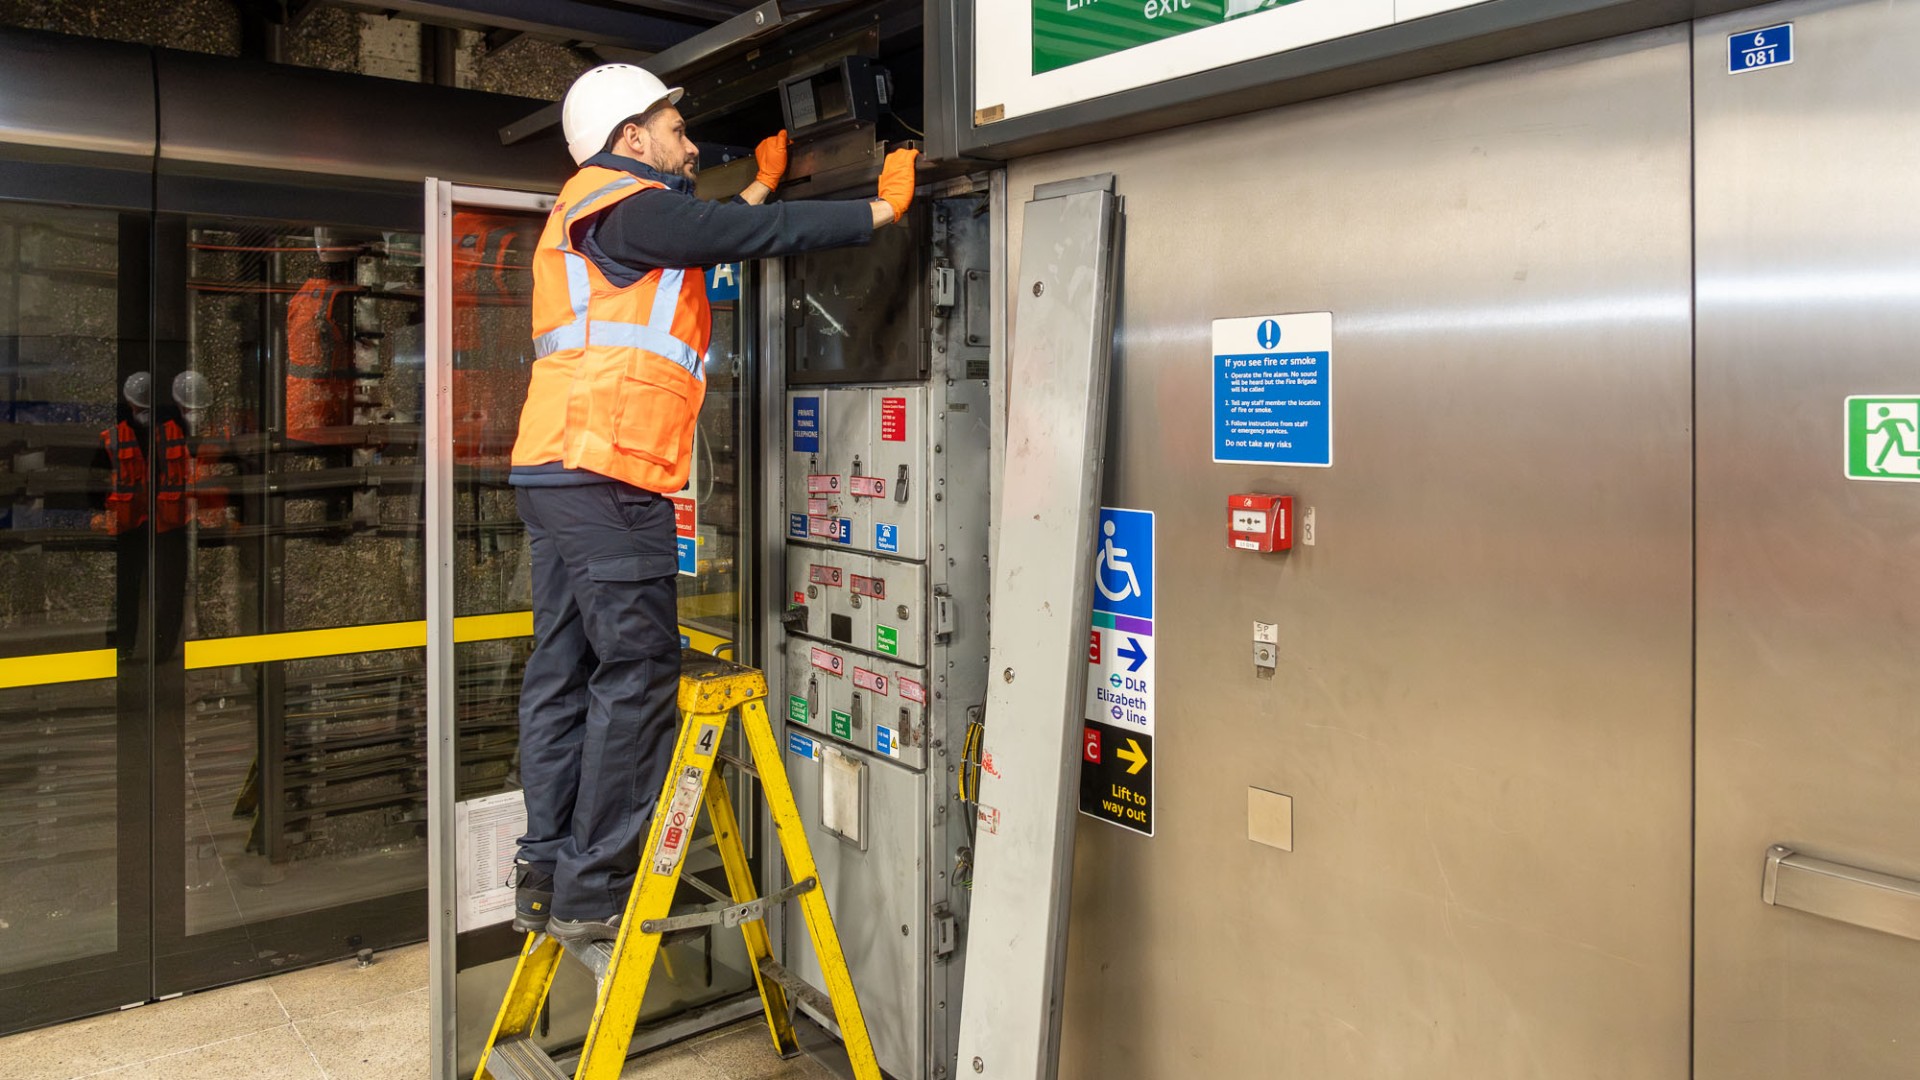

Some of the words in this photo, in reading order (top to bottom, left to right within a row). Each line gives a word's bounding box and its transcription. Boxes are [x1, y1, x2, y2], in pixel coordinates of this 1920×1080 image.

[1144, 0, 1191, 19] exit
[1754, 32, 1765, 46] 6
[1745, 49, 1775, 67] 081
[712, 263, 734, 289] A
[1225, 358, 1231, 367] If
[1233, 360, 1246, 369] you
[1264, 357, 1278, 366] fire
[1290, 356, 1316, 365] smoke
[1297, 378, 1317, 386] Brigade
[1264, 441, 1275, 449] any
[1125, 677, 1147, 693] DLR
[1097, 687, 1147, 711] Elizabeth
[1126, 709, 1147, 725] line
[700, 729, 713, 751] 4
[1087, 733, 1096, 741] Lift
[1087, 742, 1098, 759] C
[1112, 784, 1132, 802] Lift
[1133, 792, 1147, 806] to
[1103, 799, 1124, 817] way
[1126, 807, 1147, 823] out
